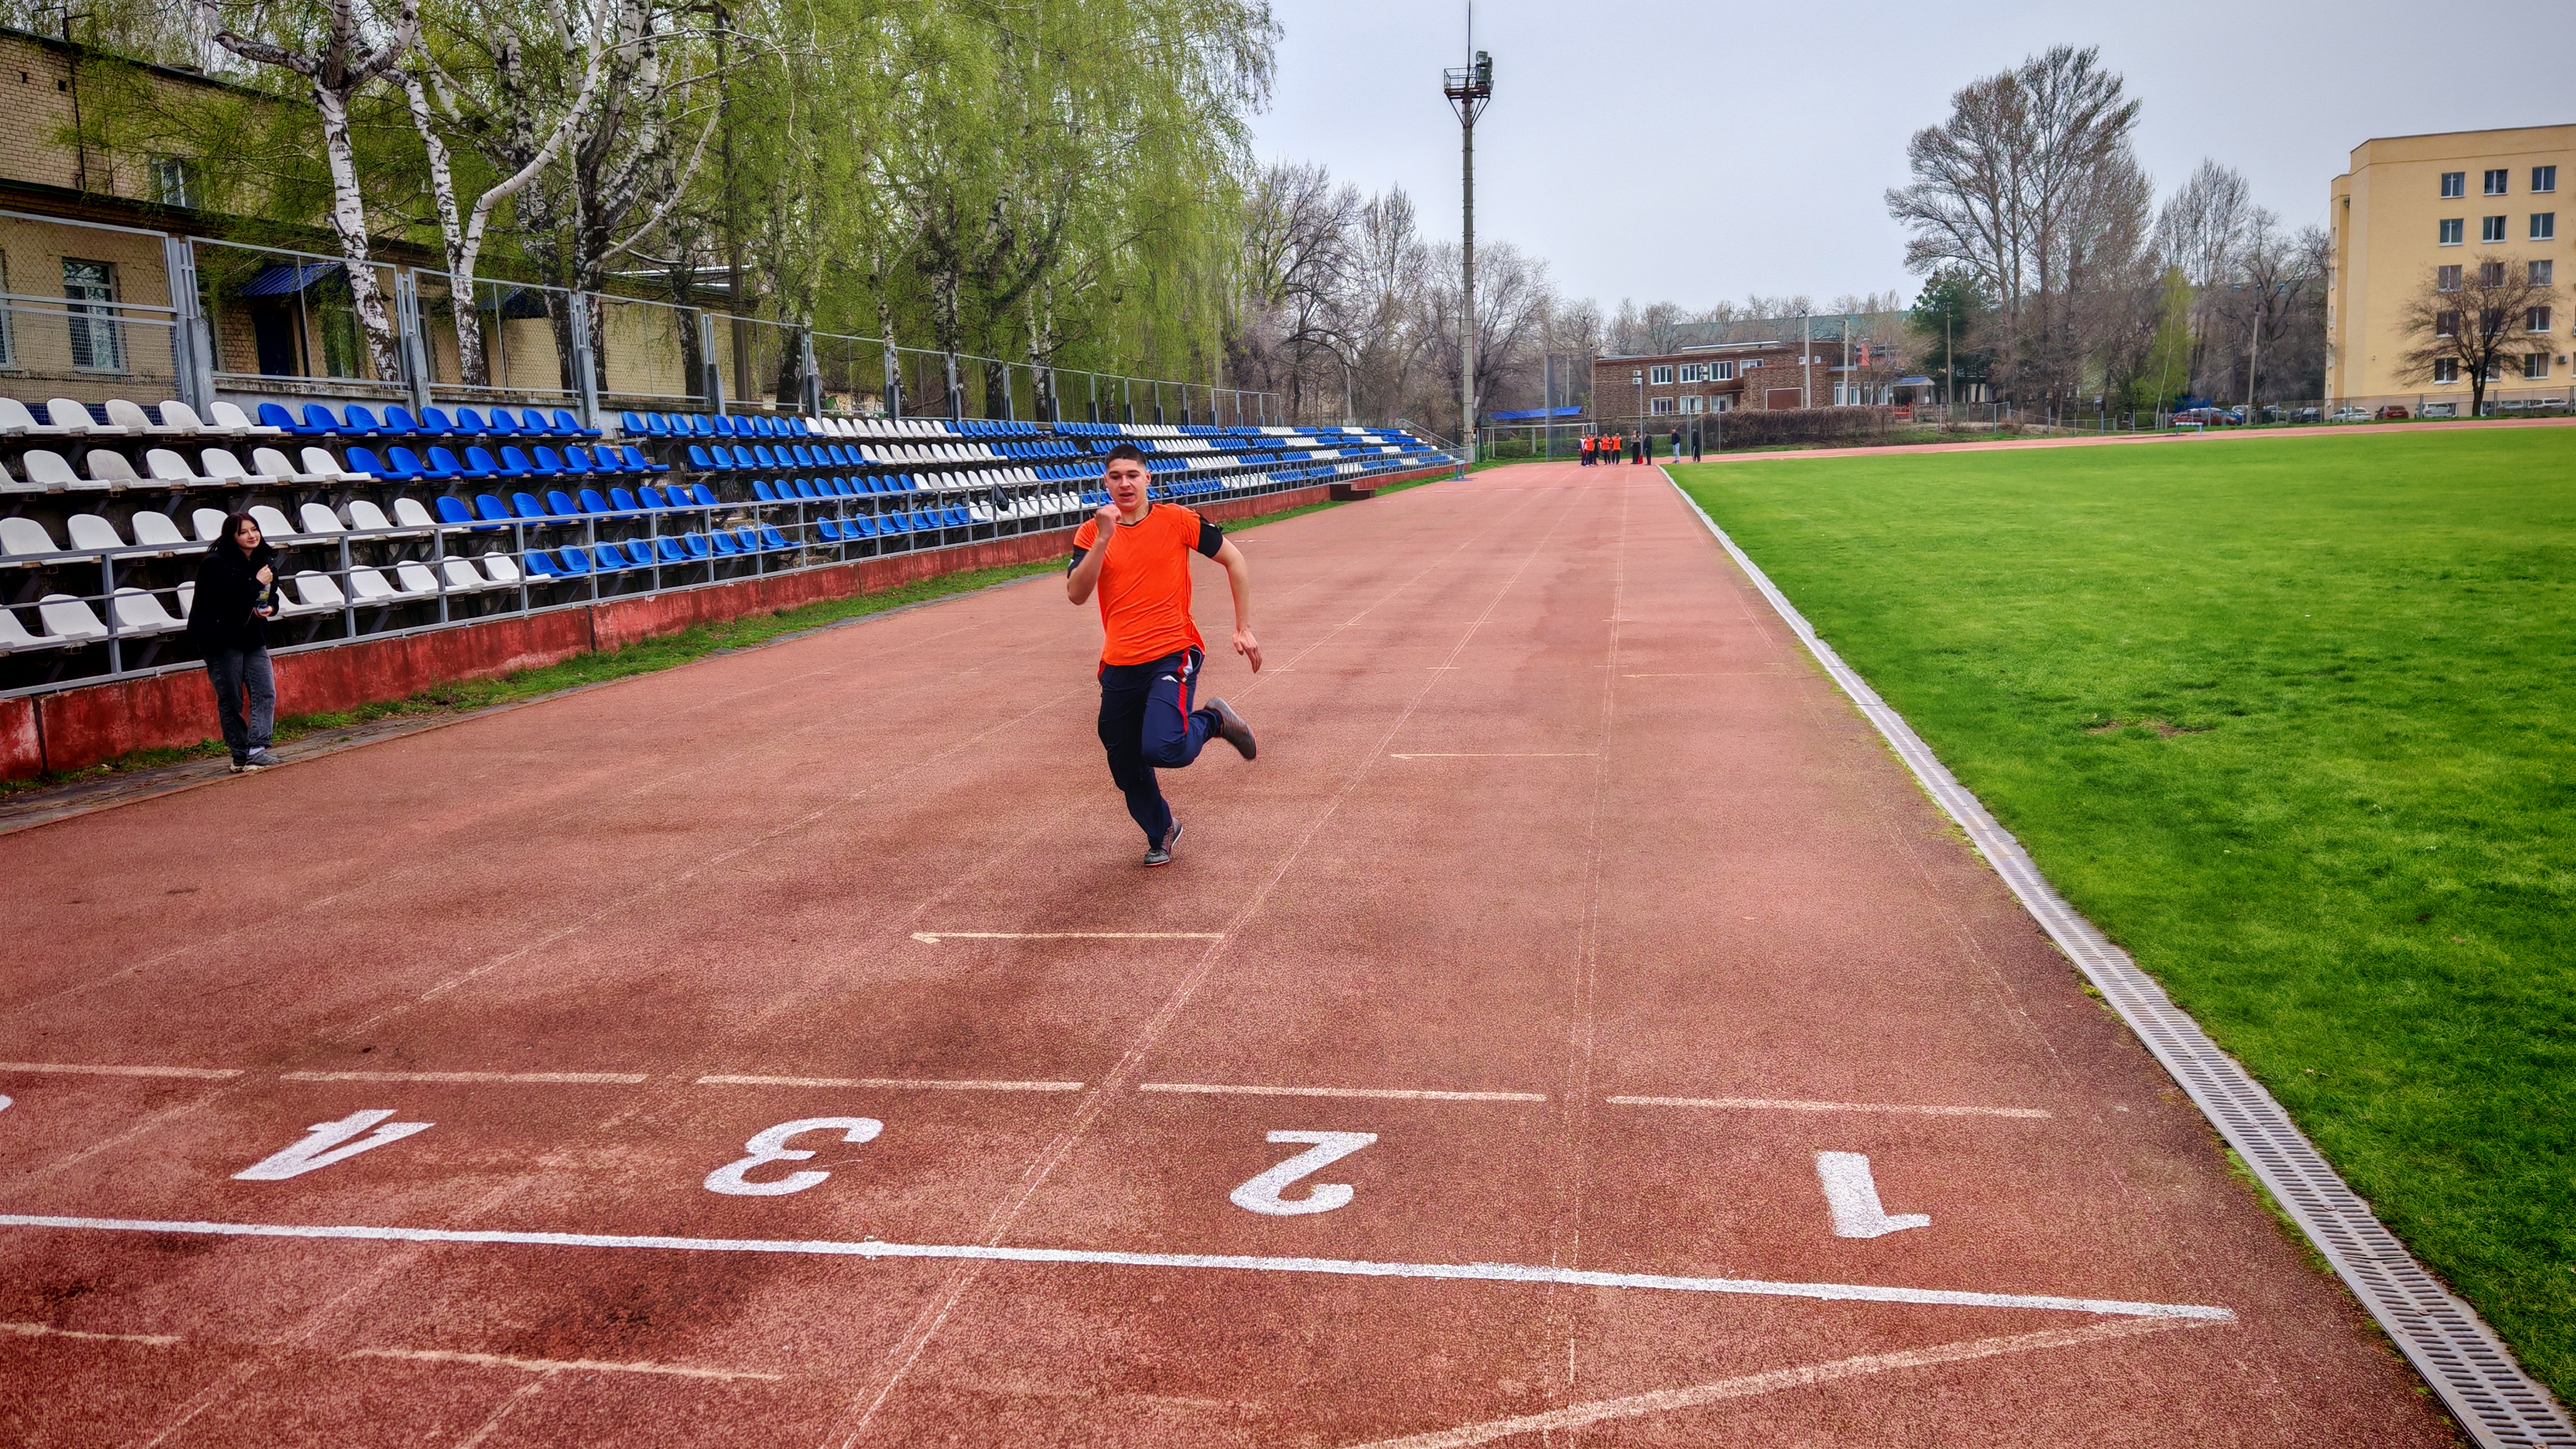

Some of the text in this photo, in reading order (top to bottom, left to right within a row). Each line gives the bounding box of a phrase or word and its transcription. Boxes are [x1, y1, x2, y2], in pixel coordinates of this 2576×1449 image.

[230, 1109, 436, 1180] 4
[702, 1116, 884, 1196] 3
[1230, 1130, 1379, 1216] 2
[1816, 1150, 1931, 1238] 1
